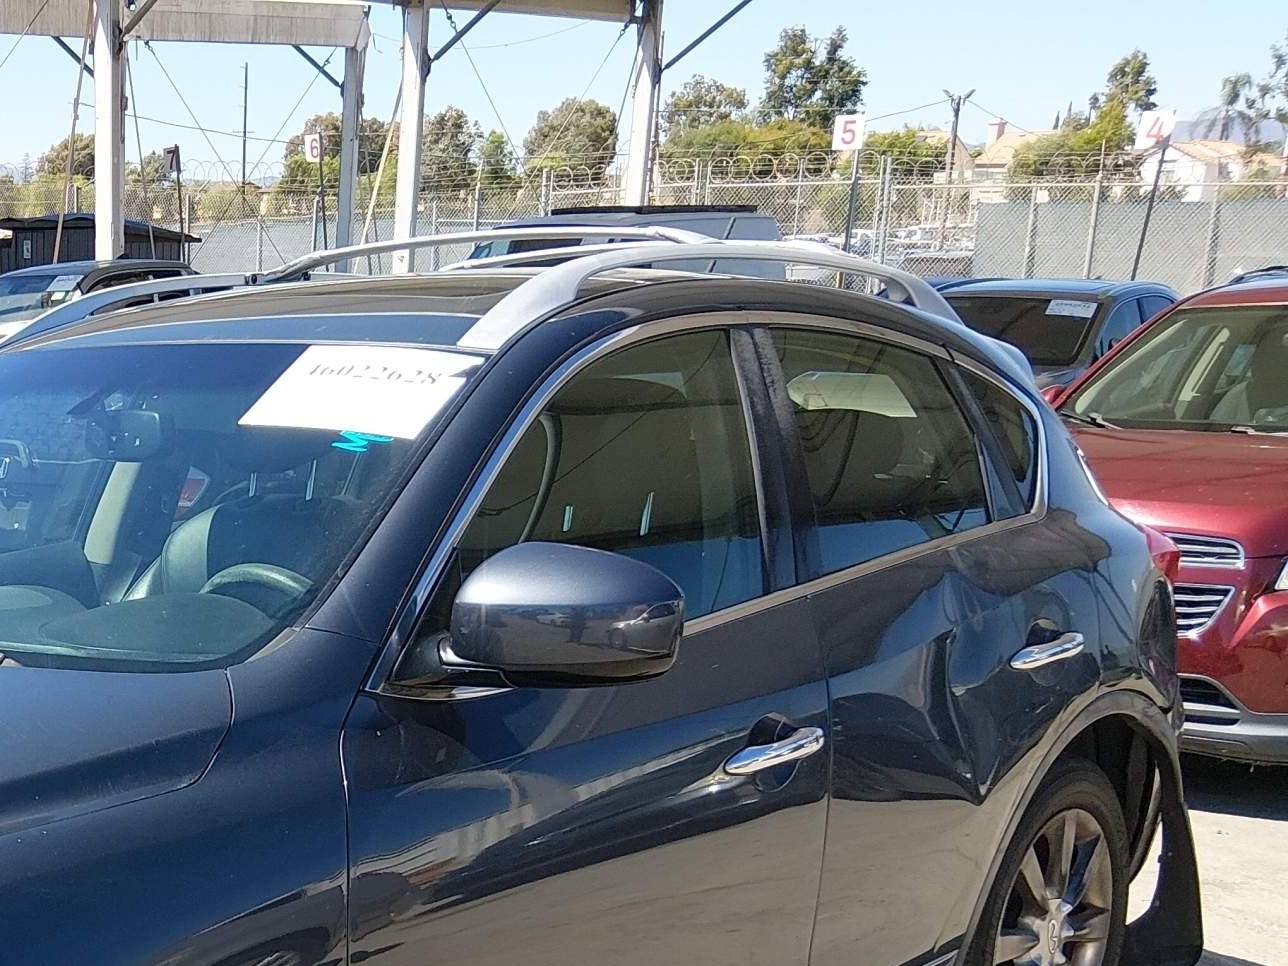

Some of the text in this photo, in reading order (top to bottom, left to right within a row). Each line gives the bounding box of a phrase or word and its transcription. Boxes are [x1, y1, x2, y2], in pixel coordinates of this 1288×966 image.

[840, 119, 857, 145] 5
[1146, 116, 1162, 145] 4
[166, 149, 177, 170] 7
[310, 138, 319, 159] 6
